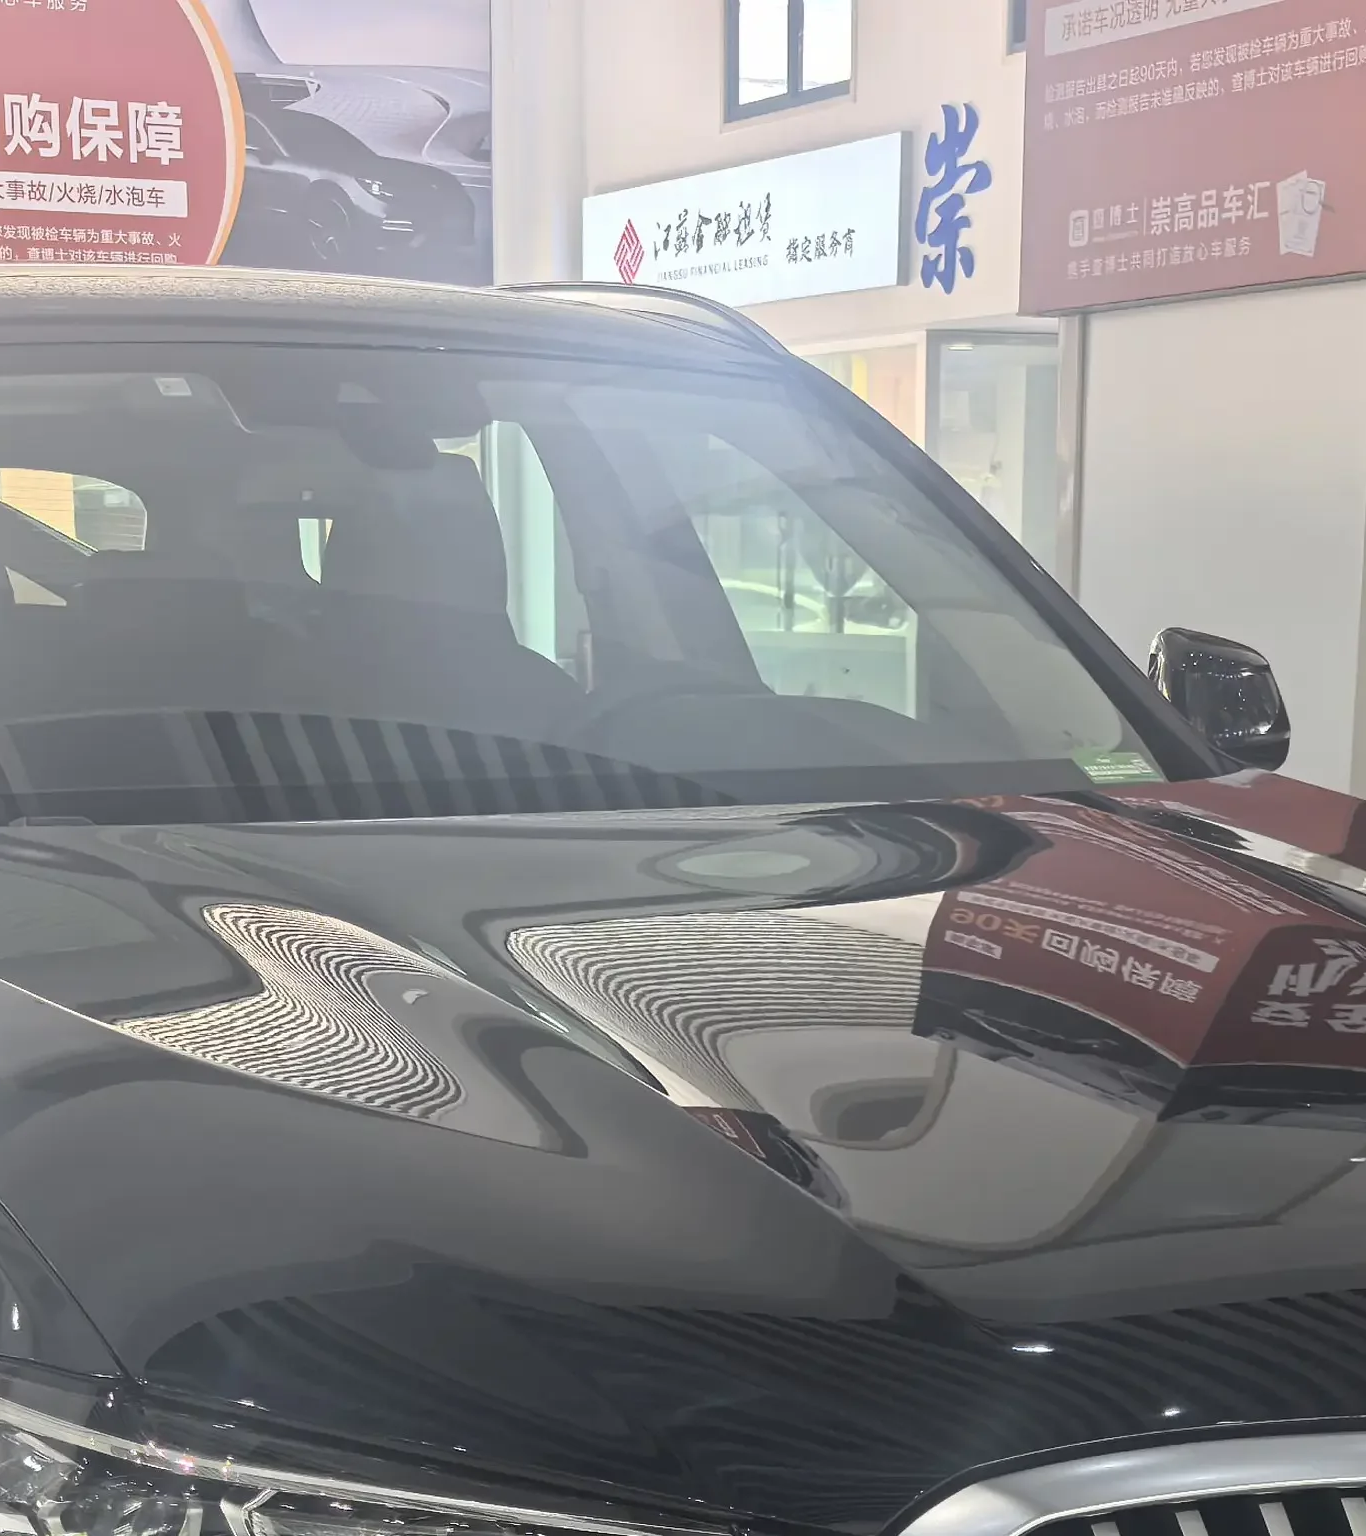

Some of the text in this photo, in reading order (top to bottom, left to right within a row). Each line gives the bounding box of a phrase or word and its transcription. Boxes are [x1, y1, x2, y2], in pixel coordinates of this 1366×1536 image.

[1150, 181, 1271, 237] 崇高品车汇
